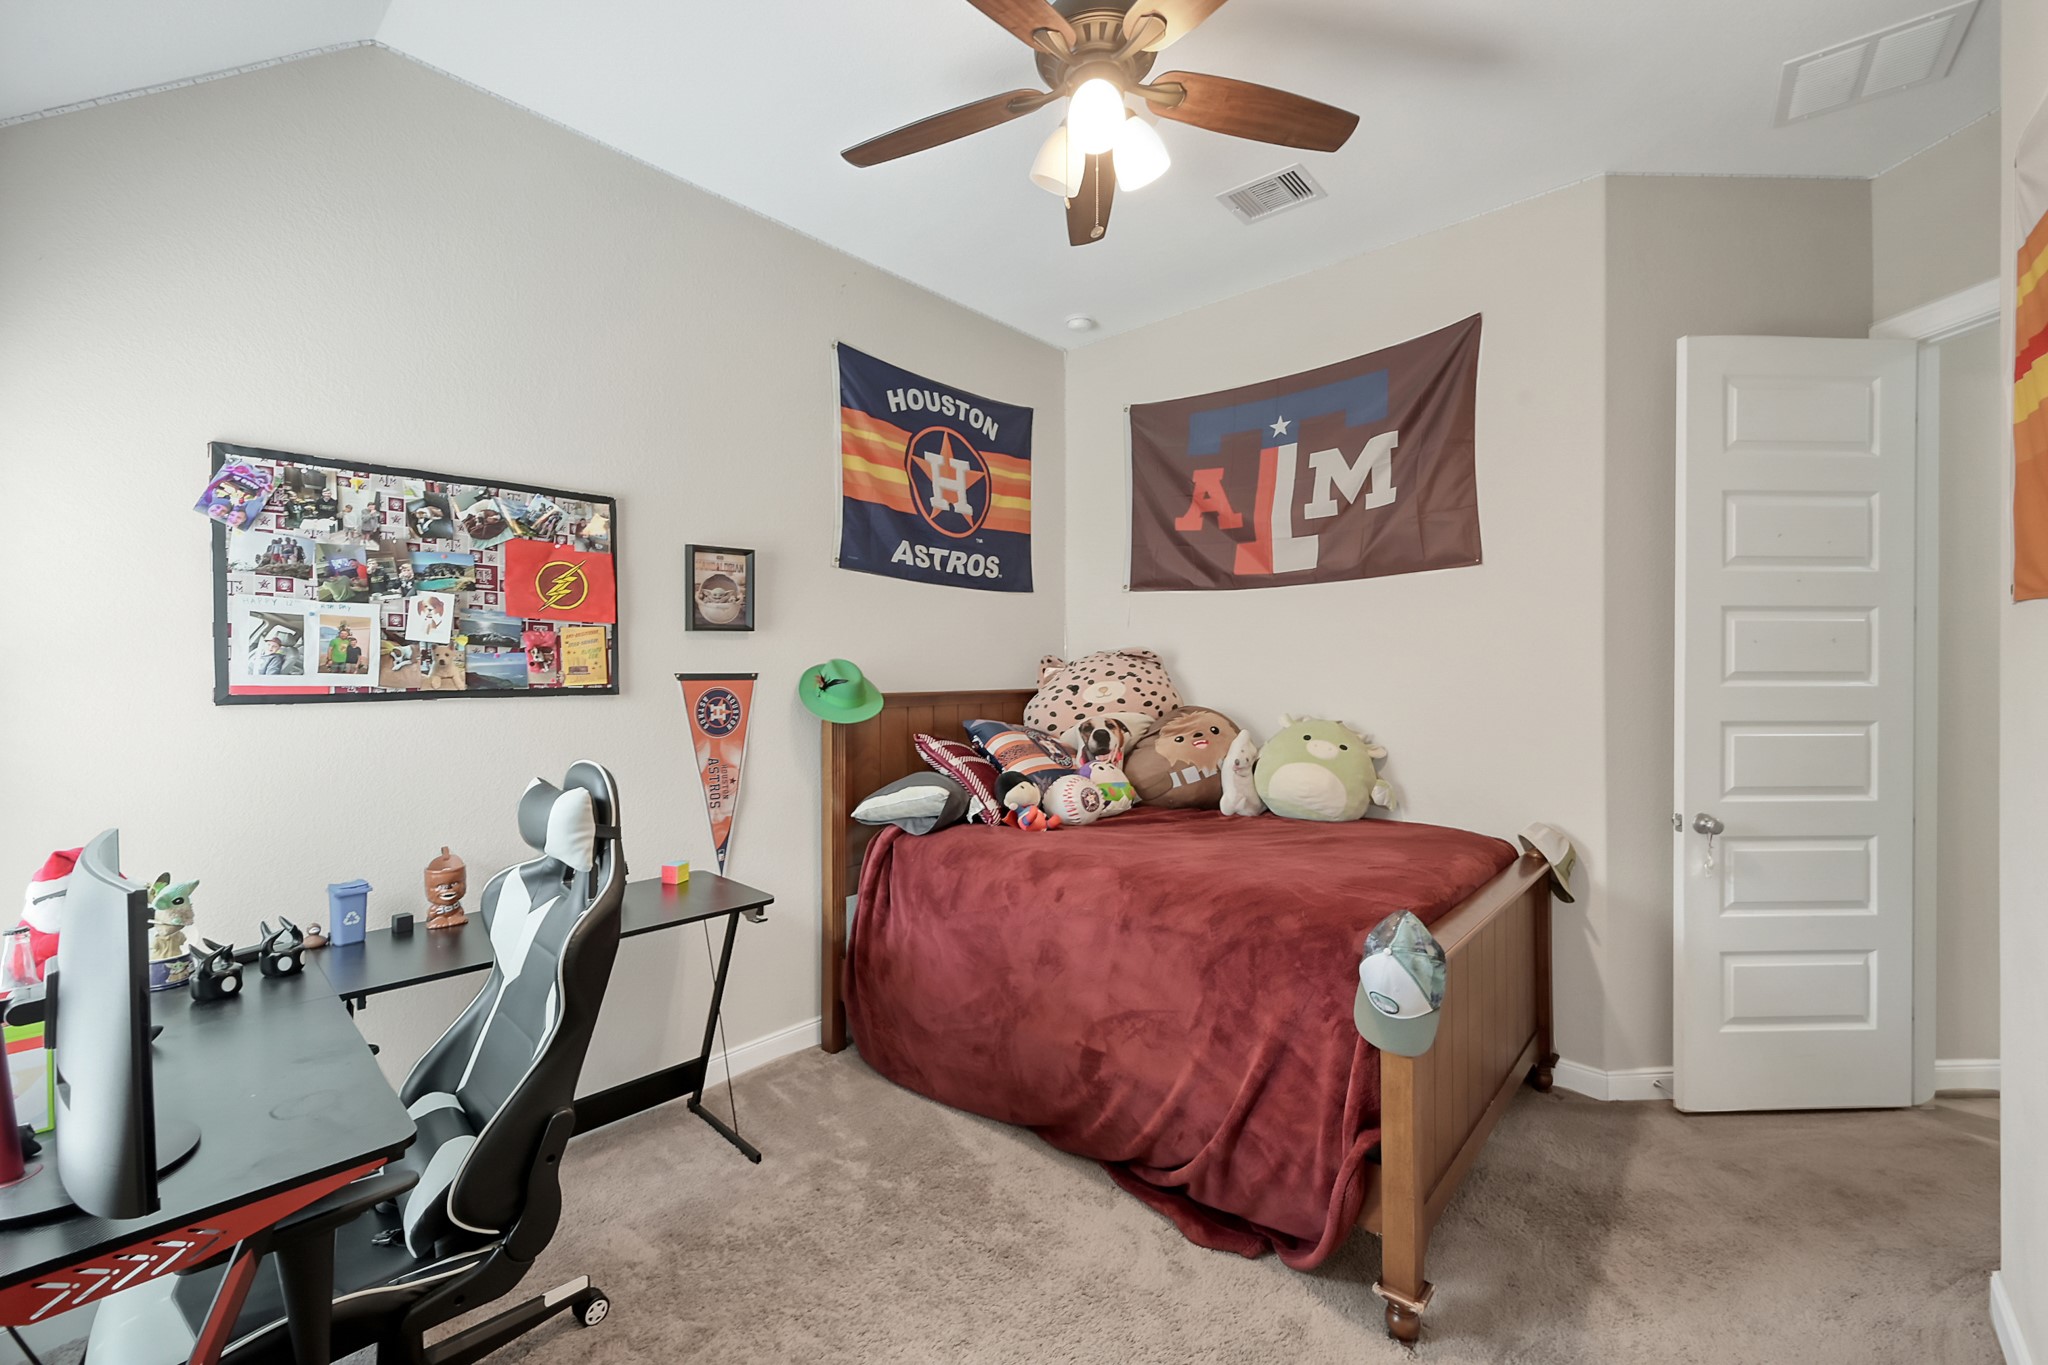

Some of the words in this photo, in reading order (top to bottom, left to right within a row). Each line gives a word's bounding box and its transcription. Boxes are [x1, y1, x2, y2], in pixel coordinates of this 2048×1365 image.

[886, 388, 999, 441] HOUSTON
[924, 451, 973, 516] H
[891, 540, 1000, 578] ASTROS
[707, 758, 721, 809] ASTROS
[721, 764, 729, 800] HOUSTON
